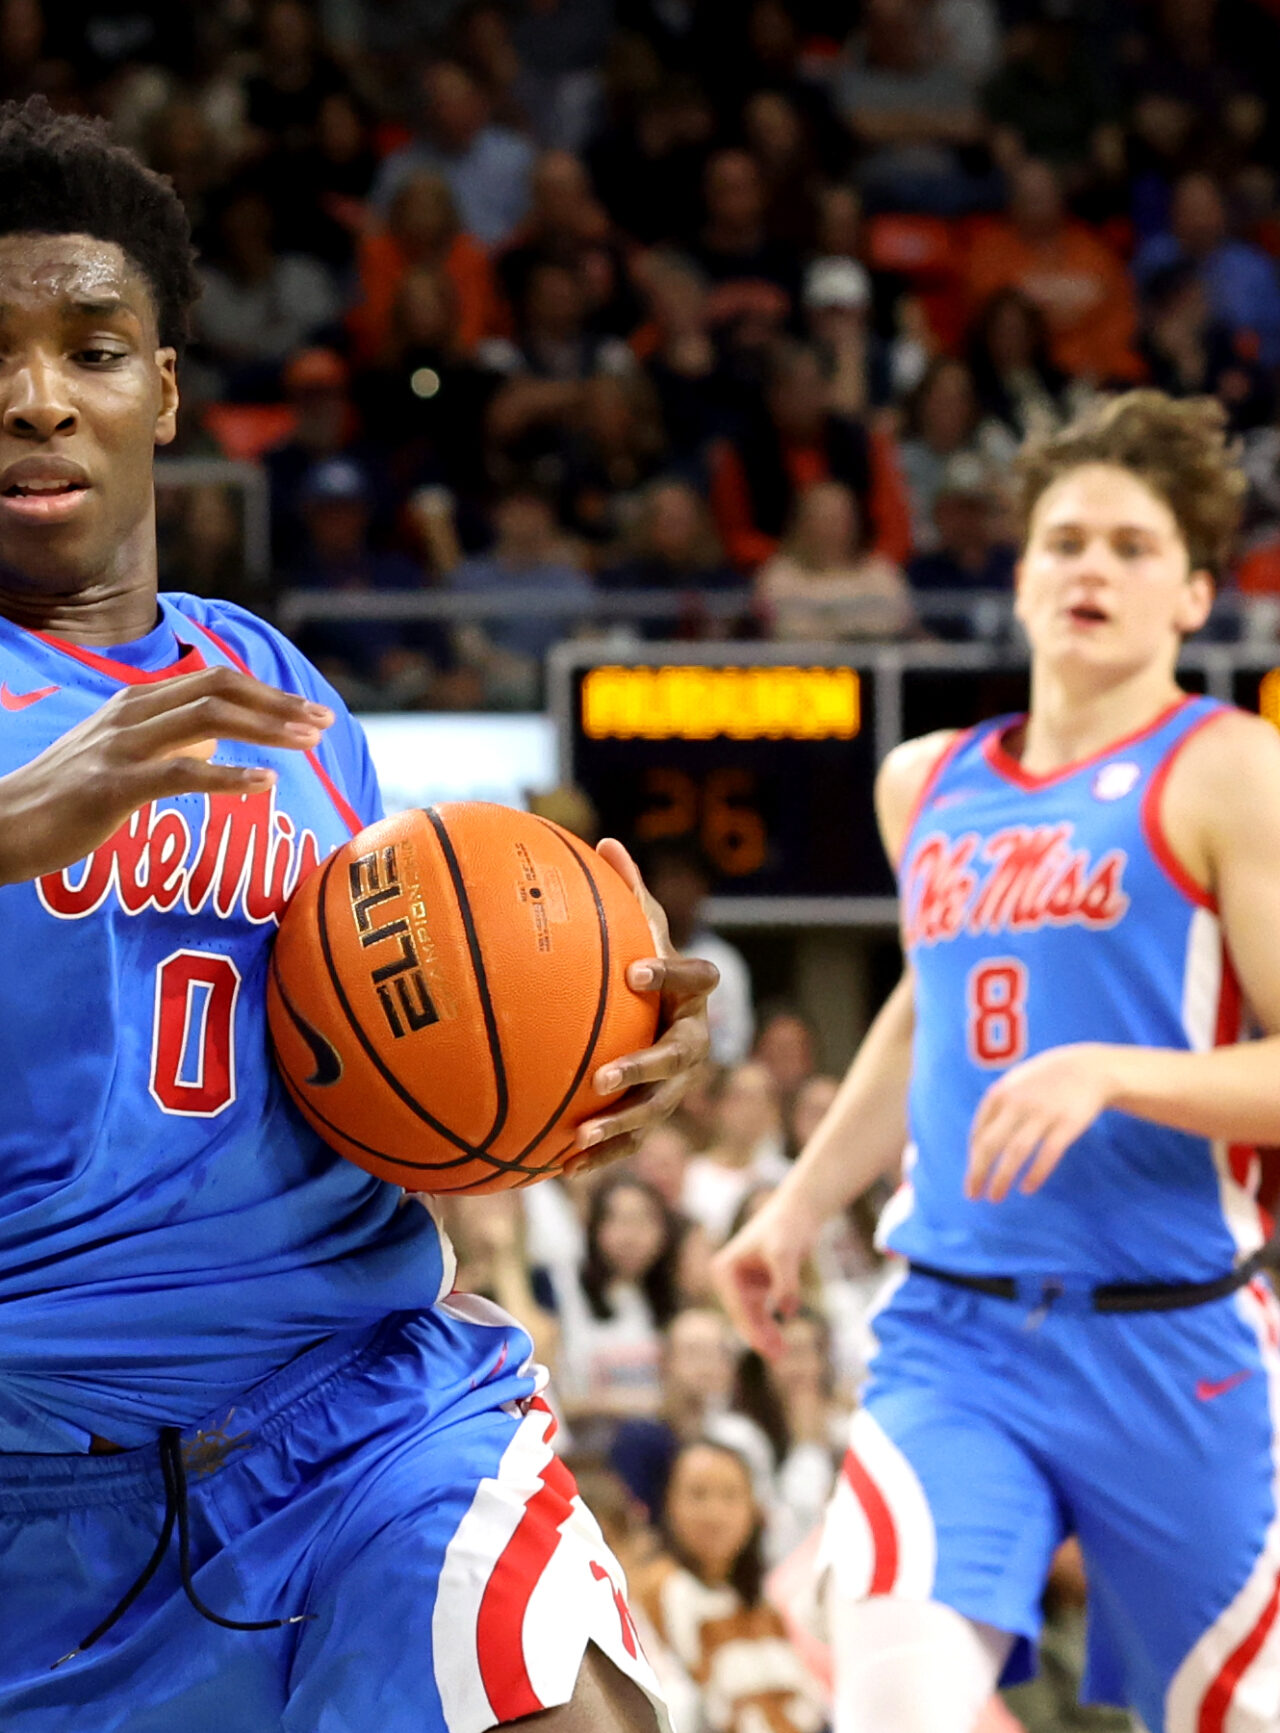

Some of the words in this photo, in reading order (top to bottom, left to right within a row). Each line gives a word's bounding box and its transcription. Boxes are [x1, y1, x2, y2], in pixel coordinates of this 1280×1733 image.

[348, 845, 440, 1039] ELITE
[970, 820, 1132, 938] Miss
[148, 948, 242, 1118] 0
[967, 957, 1029, 1068] 8
